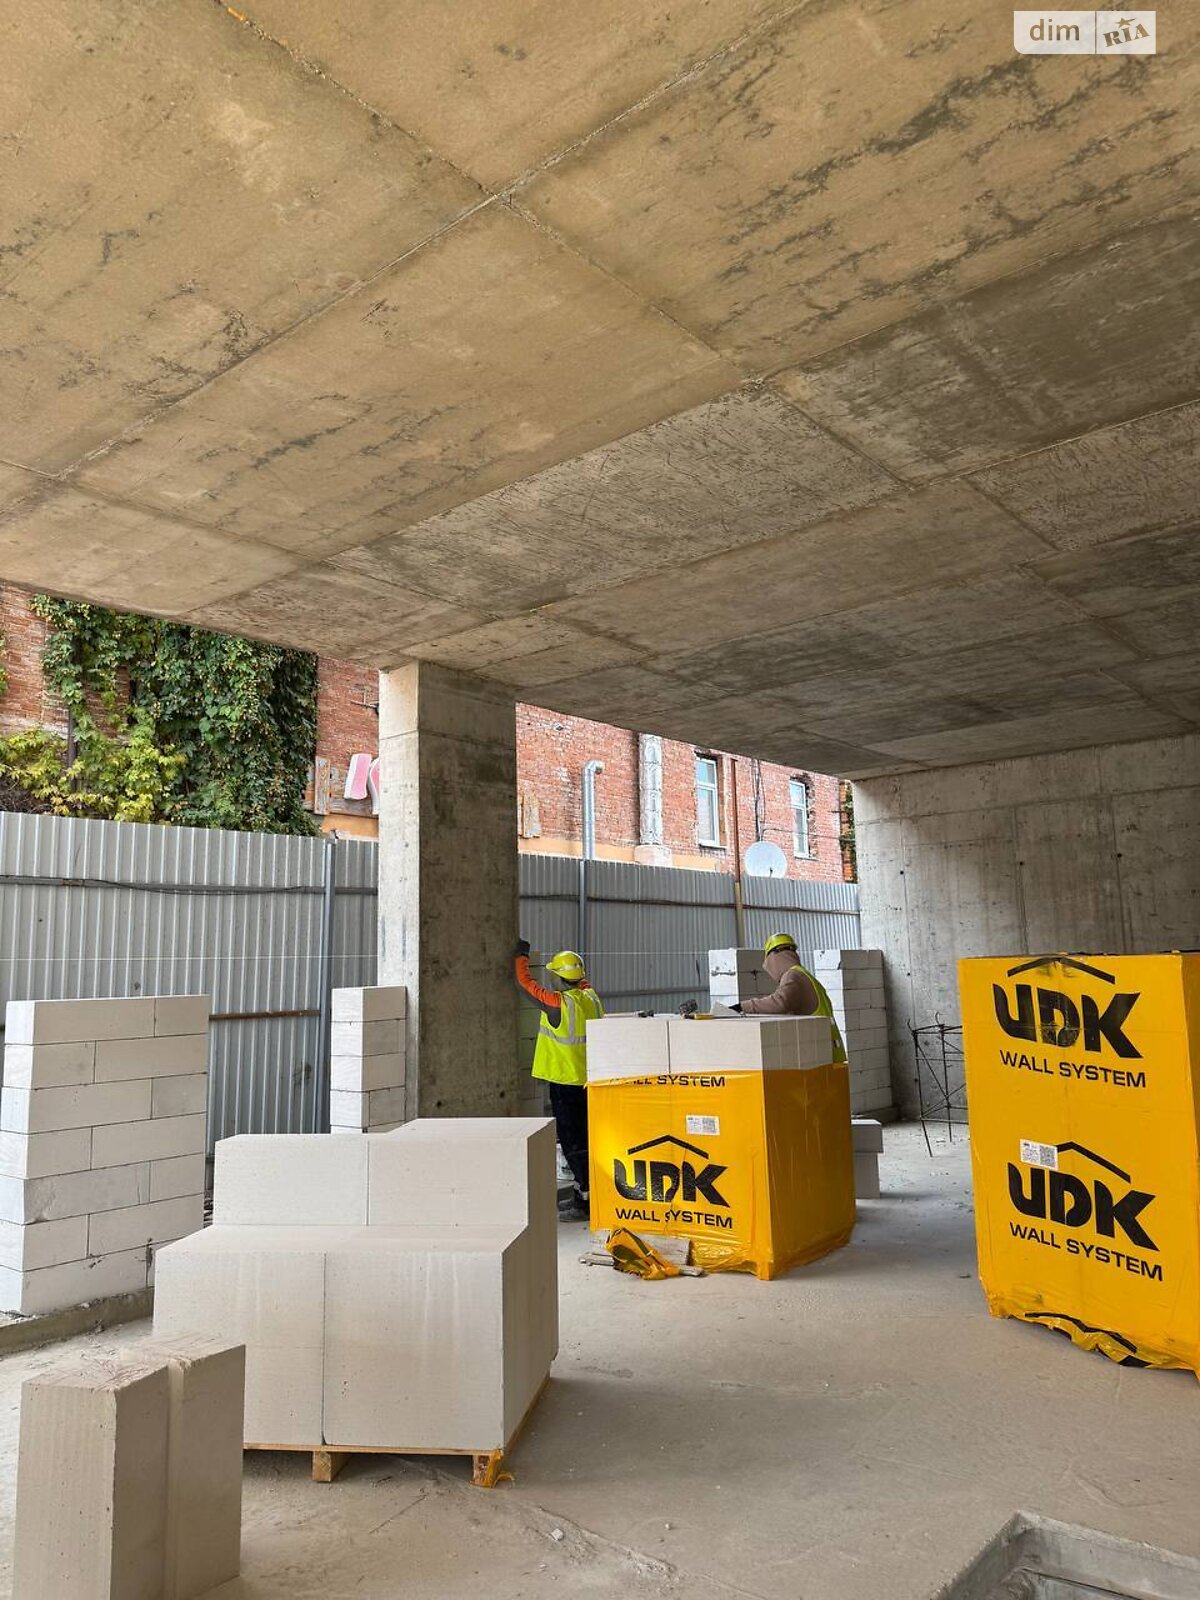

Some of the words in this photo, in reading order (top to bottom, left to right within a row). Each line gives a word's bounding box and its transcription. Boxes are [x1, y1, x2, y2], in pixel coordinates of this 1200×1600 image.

[992, 983, 1143, 1059] UDK
[656, 1074, 726, 1088] SYSTEM
[999, 1049, 1054, 1075] WALL
[1058, 1061, 1146, 1088] SYSTEM
[613, 1158, 731, 1208] UDK
[1007, 1162, 1160, 1252] UDK
[615, 1207, 661, 1222] WALL
[1009, 1222, 1062, 1249] WALL
[1066, 1238, 1164, 1282] SYSTEM
